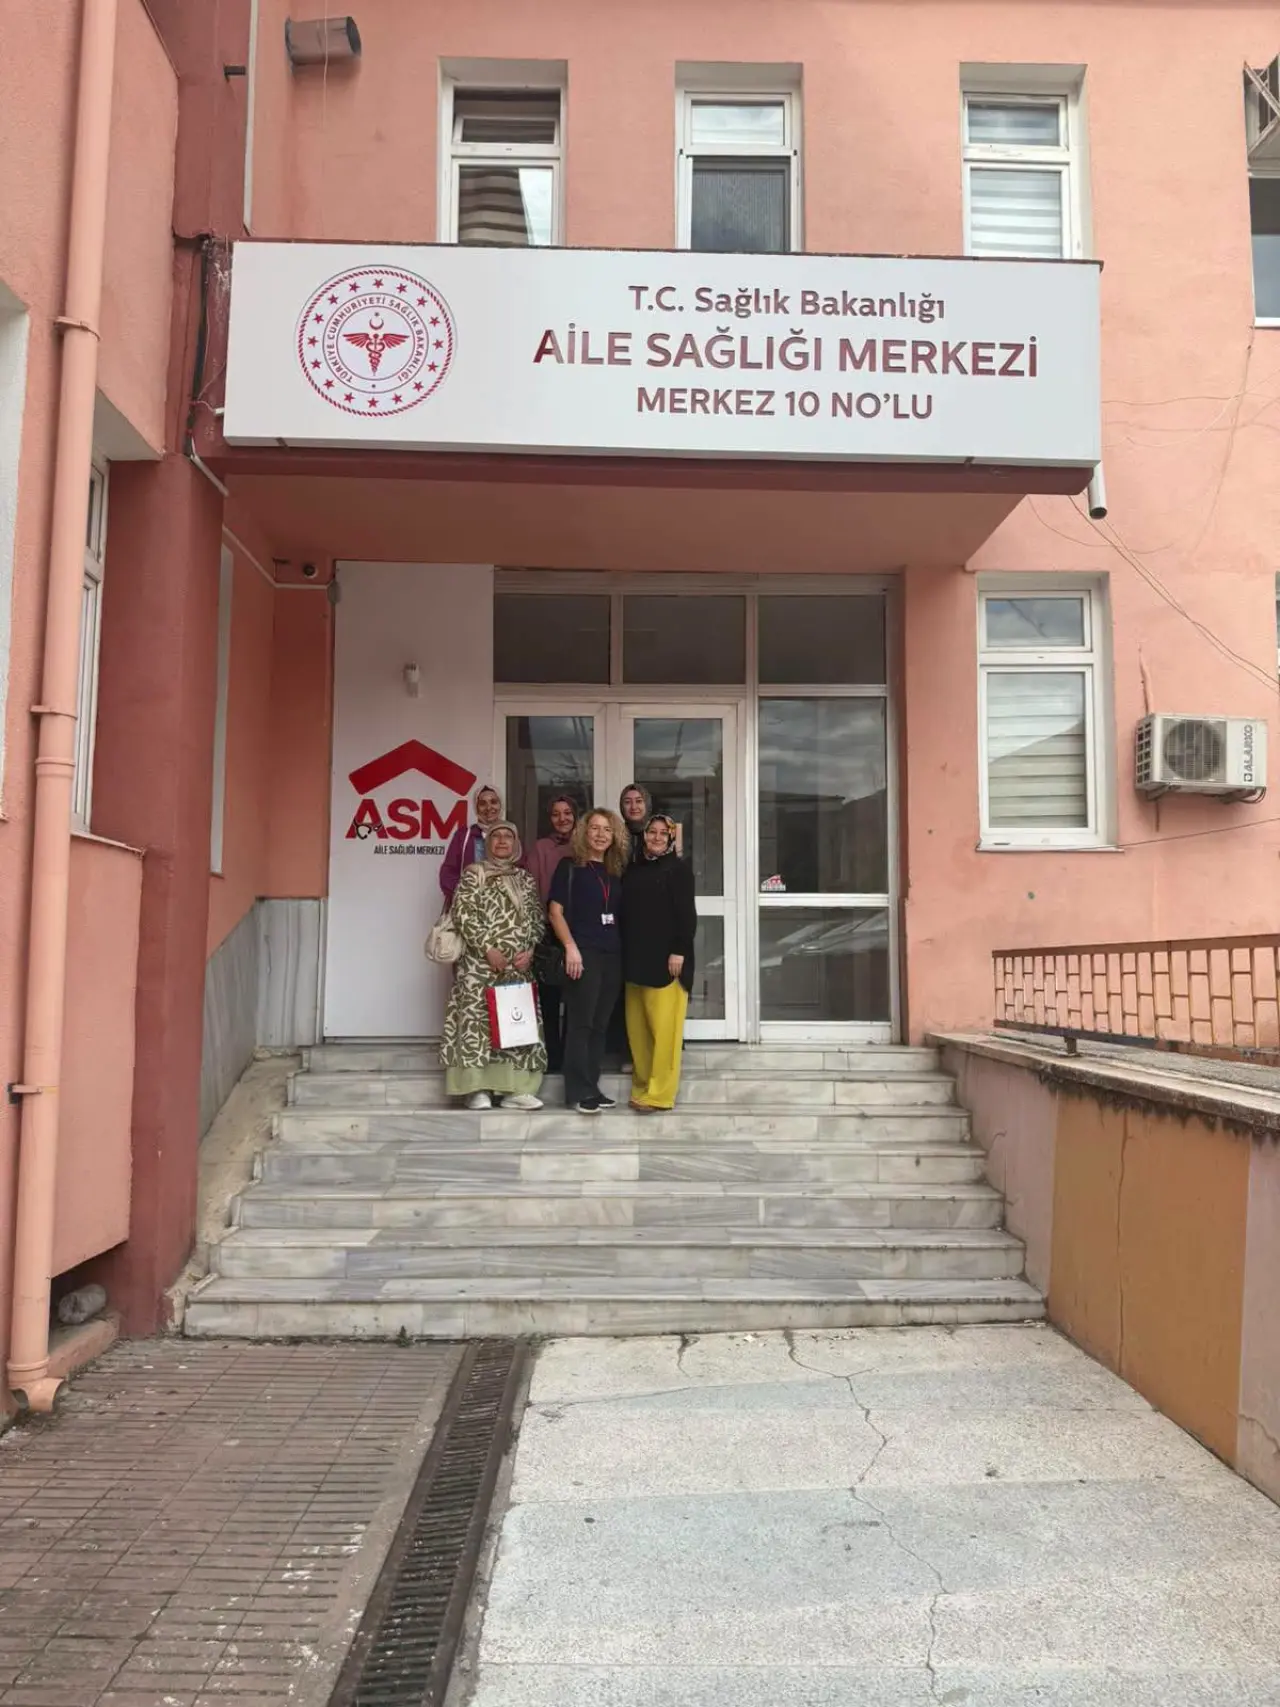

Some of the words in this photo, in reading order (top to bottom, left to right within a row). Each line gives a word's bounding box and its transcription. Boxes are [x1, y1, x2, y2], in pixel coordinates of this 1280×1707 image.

[628, 286, 684, 312] T.C.
[695, 286, 789, 319] Sağlık
[800, 290, 945, 323] Bakanlığı
[533, 323, 633, 365] AİLE
[646, 326, 822, 372] SAĞLIĞI
[839, 335, 1038, 377] MERKEZİ
[636, 387, 775, 416] MERKEZ
[785, 391, 820, 417] 10
[1244, 725, 1253, 772] ALARKO
[345, 798, 468, 840] ASM
[374, 844, 389, 855] AİLE
[389, 844, 416, 856] SAĞLIĞI
